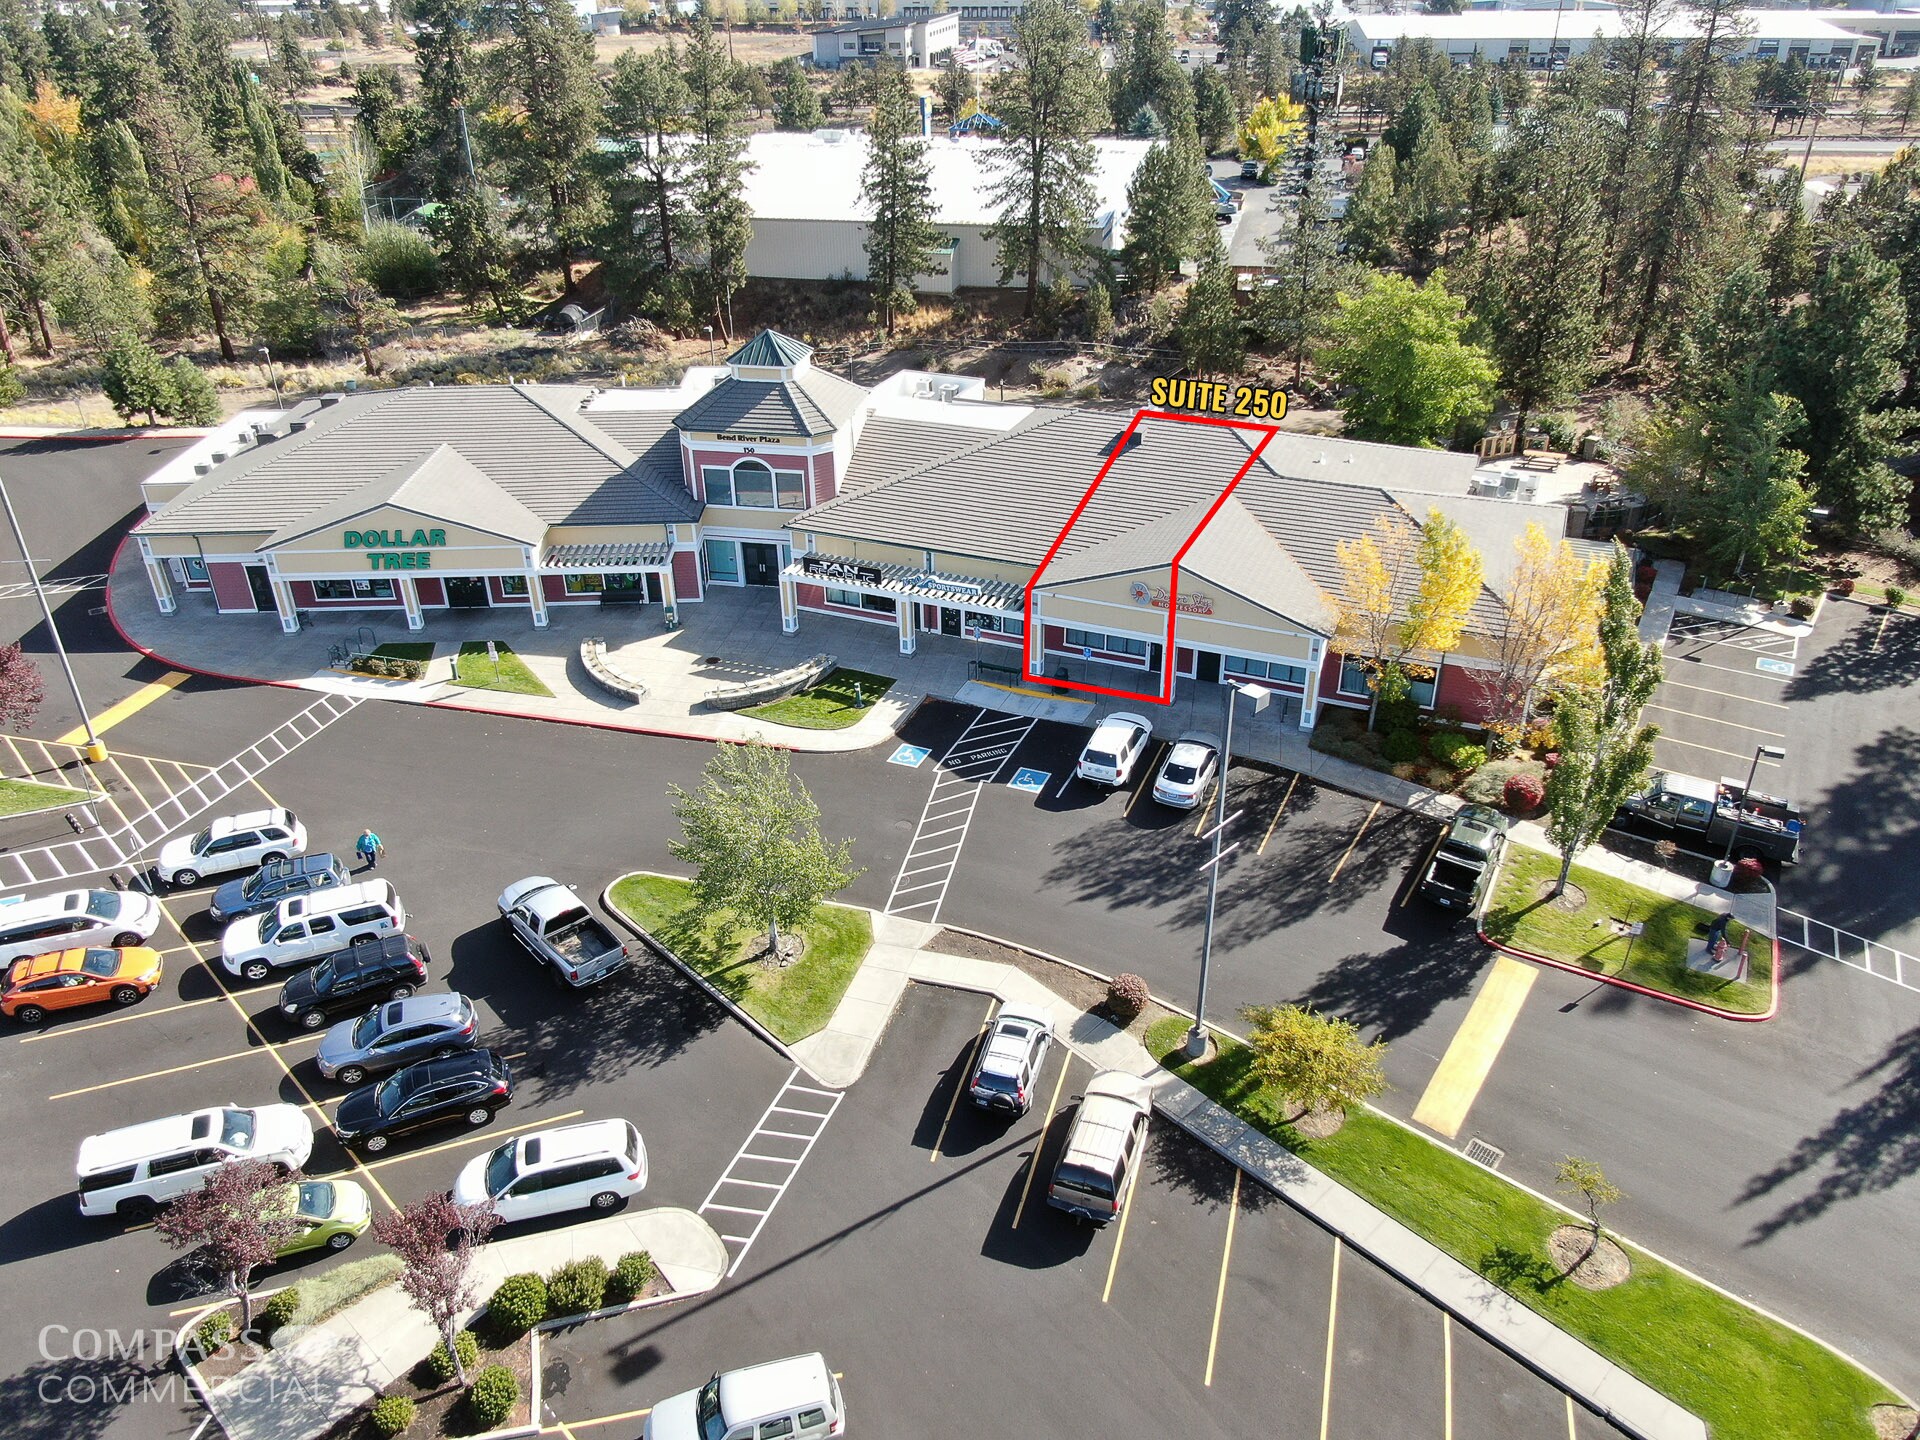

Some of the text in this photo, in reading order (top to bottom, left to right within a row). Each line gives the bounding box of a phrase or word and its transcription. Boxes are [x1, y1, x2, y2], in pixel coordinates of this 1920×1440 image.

[760, 436, 780, 444] Plaza
[344, 529, 447, 549] DOLLAR
[367, 552, 431, 570] TREE
[819, 561, 859, 575] TAN
[809, 566, 876, 584] REPUBLIC
[928, 582, 977, 595] SPORTSWEAR
[1152, 587, 1188, 604] Dert
[948, 748, 1008, 766] NO PARKING
